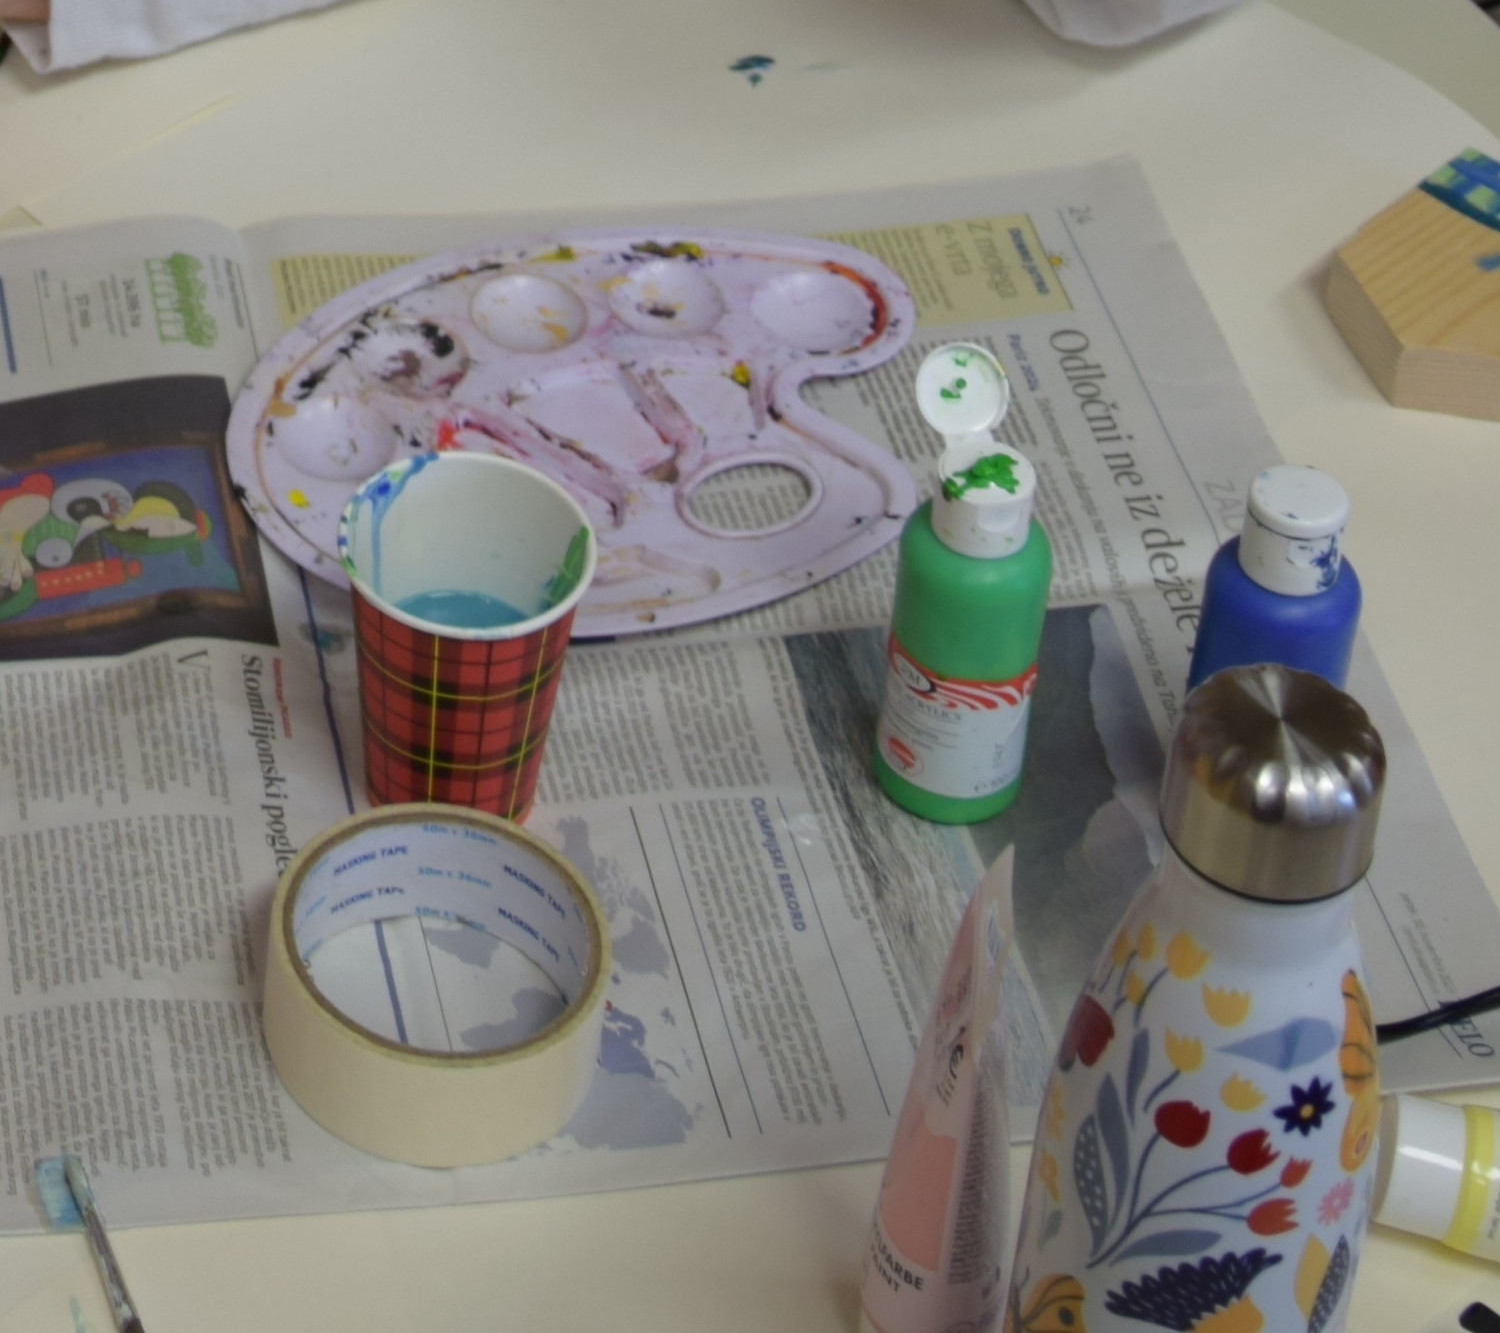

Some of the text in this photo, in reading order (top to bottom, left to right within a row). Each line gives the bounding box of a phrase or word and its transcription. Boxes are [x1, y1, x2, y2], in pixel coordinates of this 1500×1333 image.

[1049, 330, 1214, 628] Odločni ne iz dežele
[241, 655, 288, 799] Stomilijonski
[333, 845, 408, 876] MASKING TAPE
[330, 891, 373, 914] MASKING
[503, 865, 566, 920] MASKING TAPE
[775, 872, 806, 931] REKORD
[498, 907, 560, 962] MASKING TAPE
